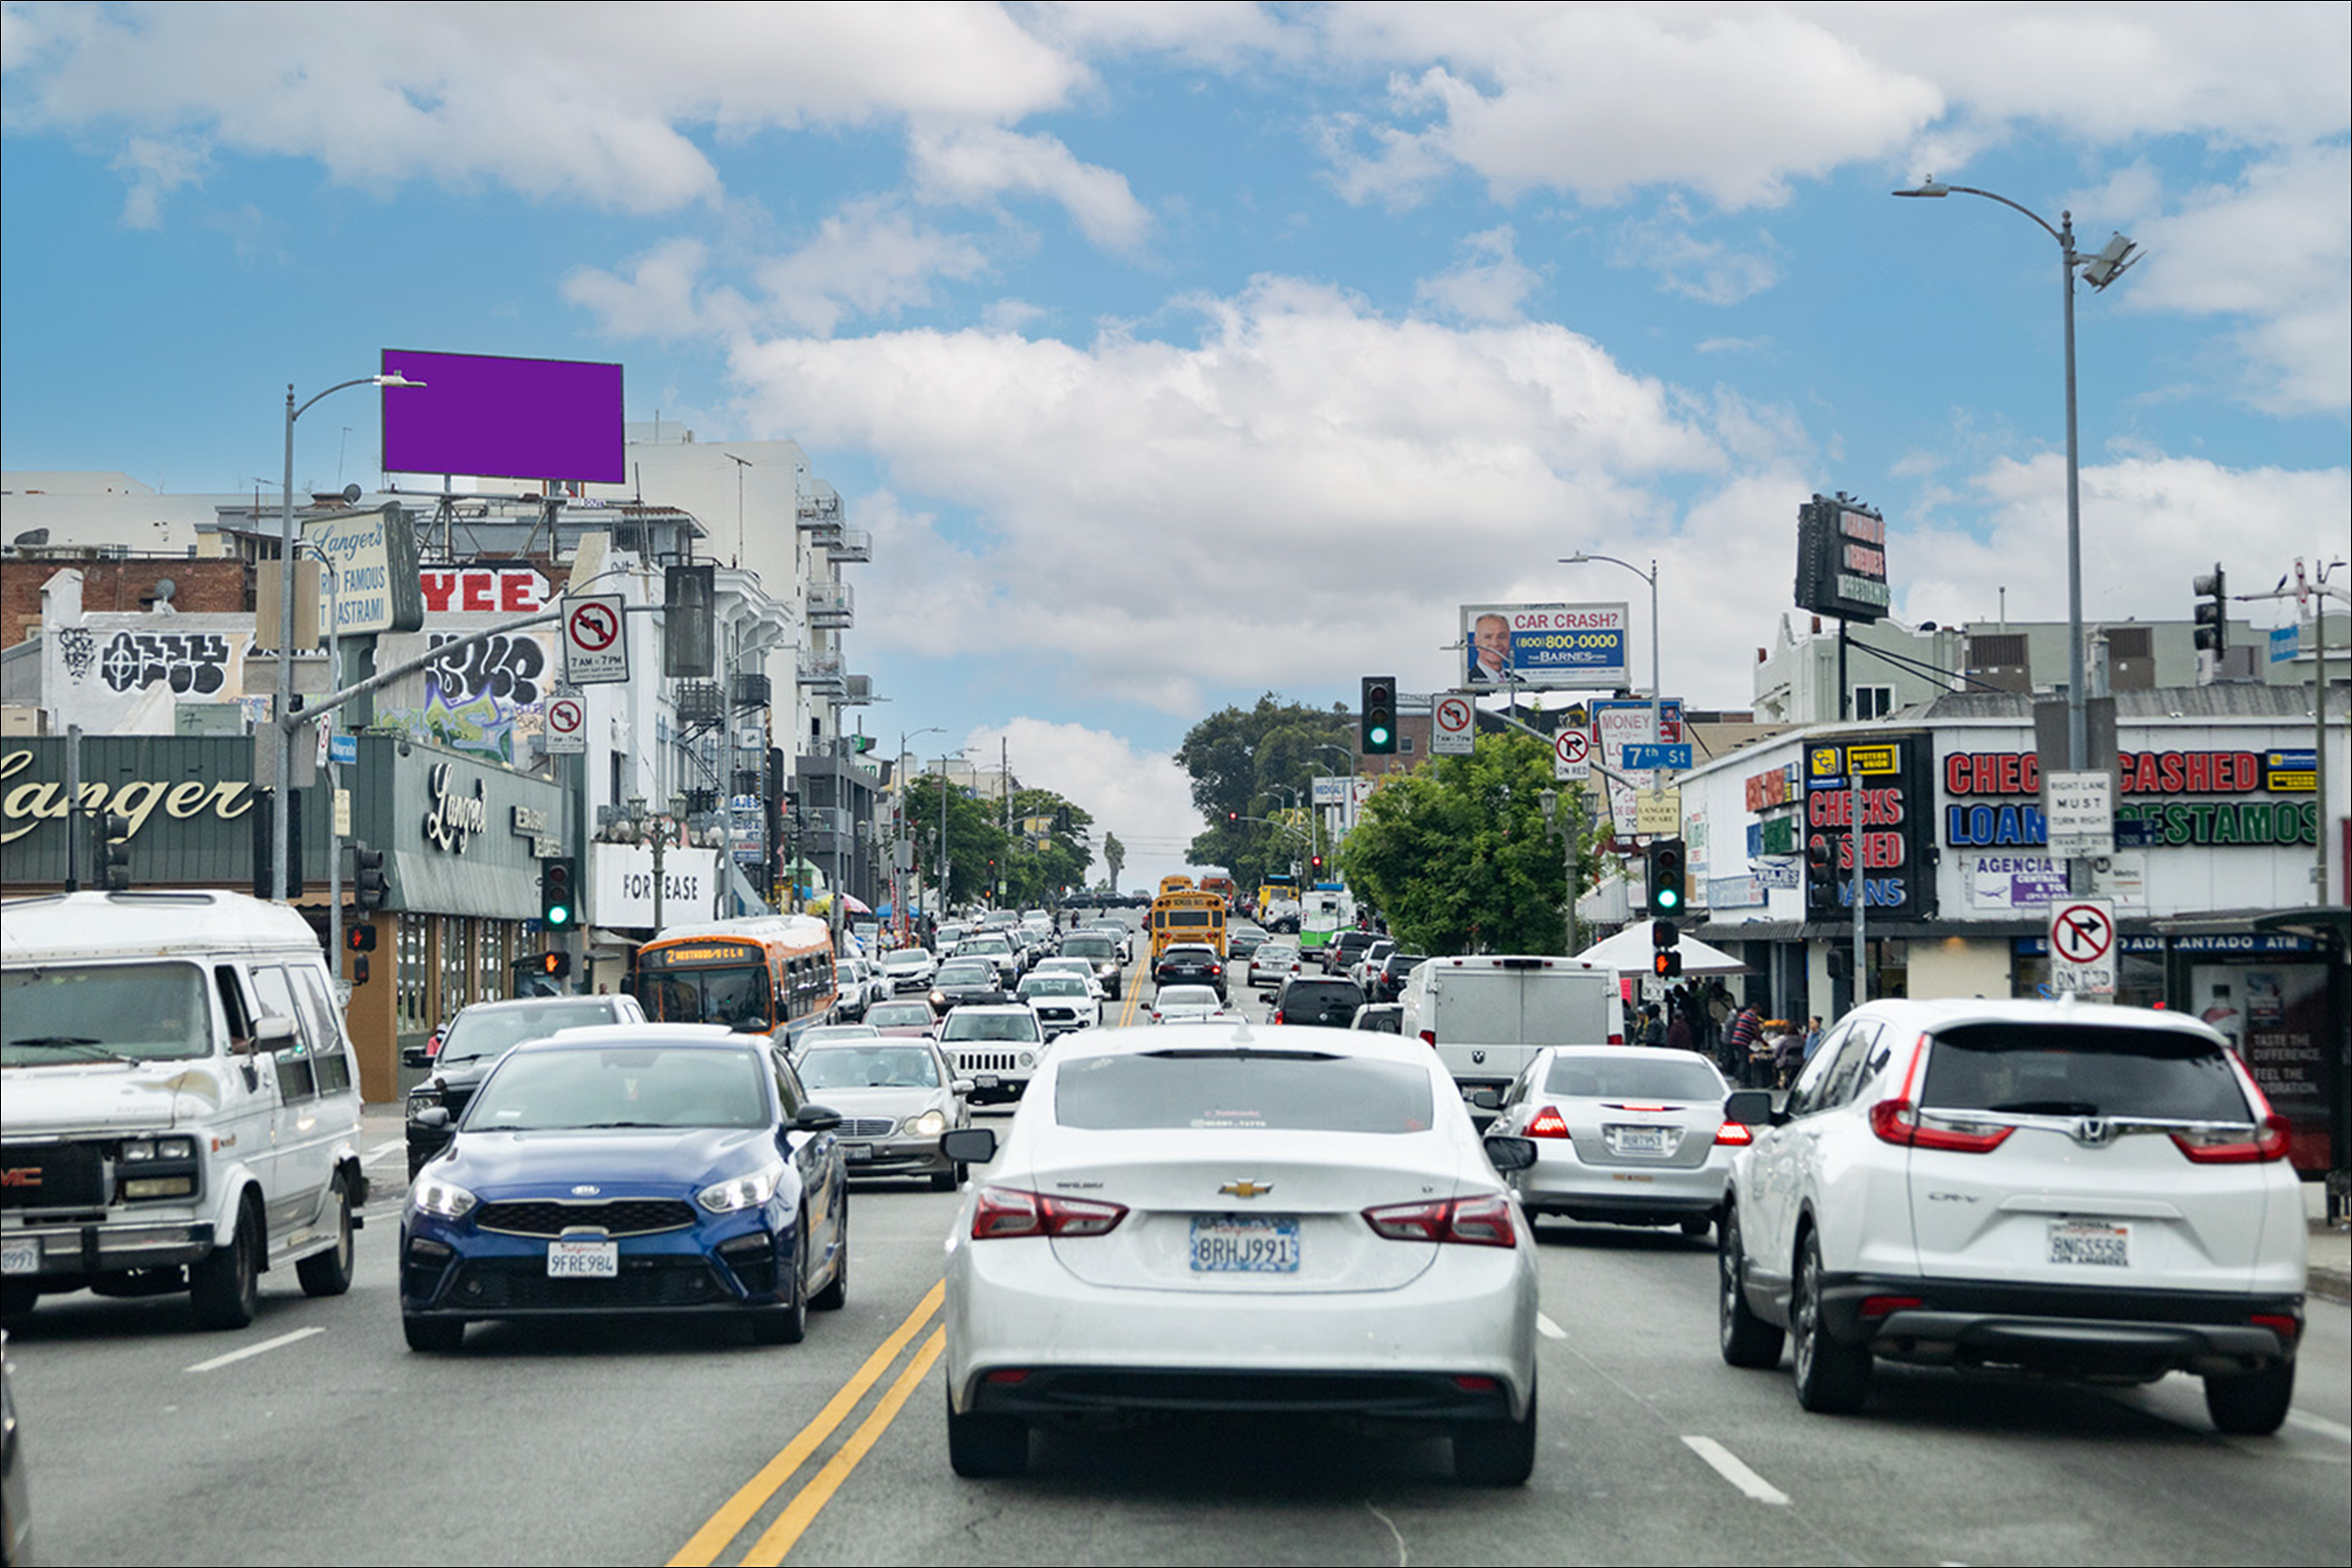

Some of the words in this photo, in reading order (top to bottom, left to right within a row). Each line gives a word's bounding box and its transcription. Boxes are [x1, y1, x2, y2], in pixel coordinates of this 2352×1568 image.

[304, 522, 384, 563] Langer's
[344, 565, 385, 593] FAMOUS
[337, 598, 384, 624] ASTRAMI
[1514, 614, 1548, 629] CAR
[1554, 612, 1618, 628] CRASH?
[1540, 651, 1592, 662] BARNES
[1601, 714, 1650, 729] MONEY
[1628, 748, 1659, 766] 7th
[1668, 750, 1686, 763] St
[1558, 766, 1571, 775] ON
[1572, 766, 1588, 775] RED
[1947, 754, 2039, 793] CHEC
[2118, 754, 2259, 792] CASHED
[2082, 781, 2106, 791] LANE
[1809, 788, 1900, 827] CHECKS
[2058, 798, 2101, 808] MUST
[1949, 806, 2047, 845] LOAN
[2052, 816, 2076, 825] TURN
[2081, 815, 2107, 824] RIGHT
[1810, 832, 1900, 868] SHED
[1977, 858, 2054, 873] AGENCIA
[623, 874, 651, 900] FOR
[662, 875, 698, 900] EASE
[2132, 938, 2254, 950] ADEANTADO
[2266, 937, 2299, 949] ATM
[666, 949, 675, 963] 2
[0, 1167, 42, 1187] MC
[1200, 1238, 1289, 1263] 8RHJ991
[552, 1254, 613, 1272] 9FRE984
